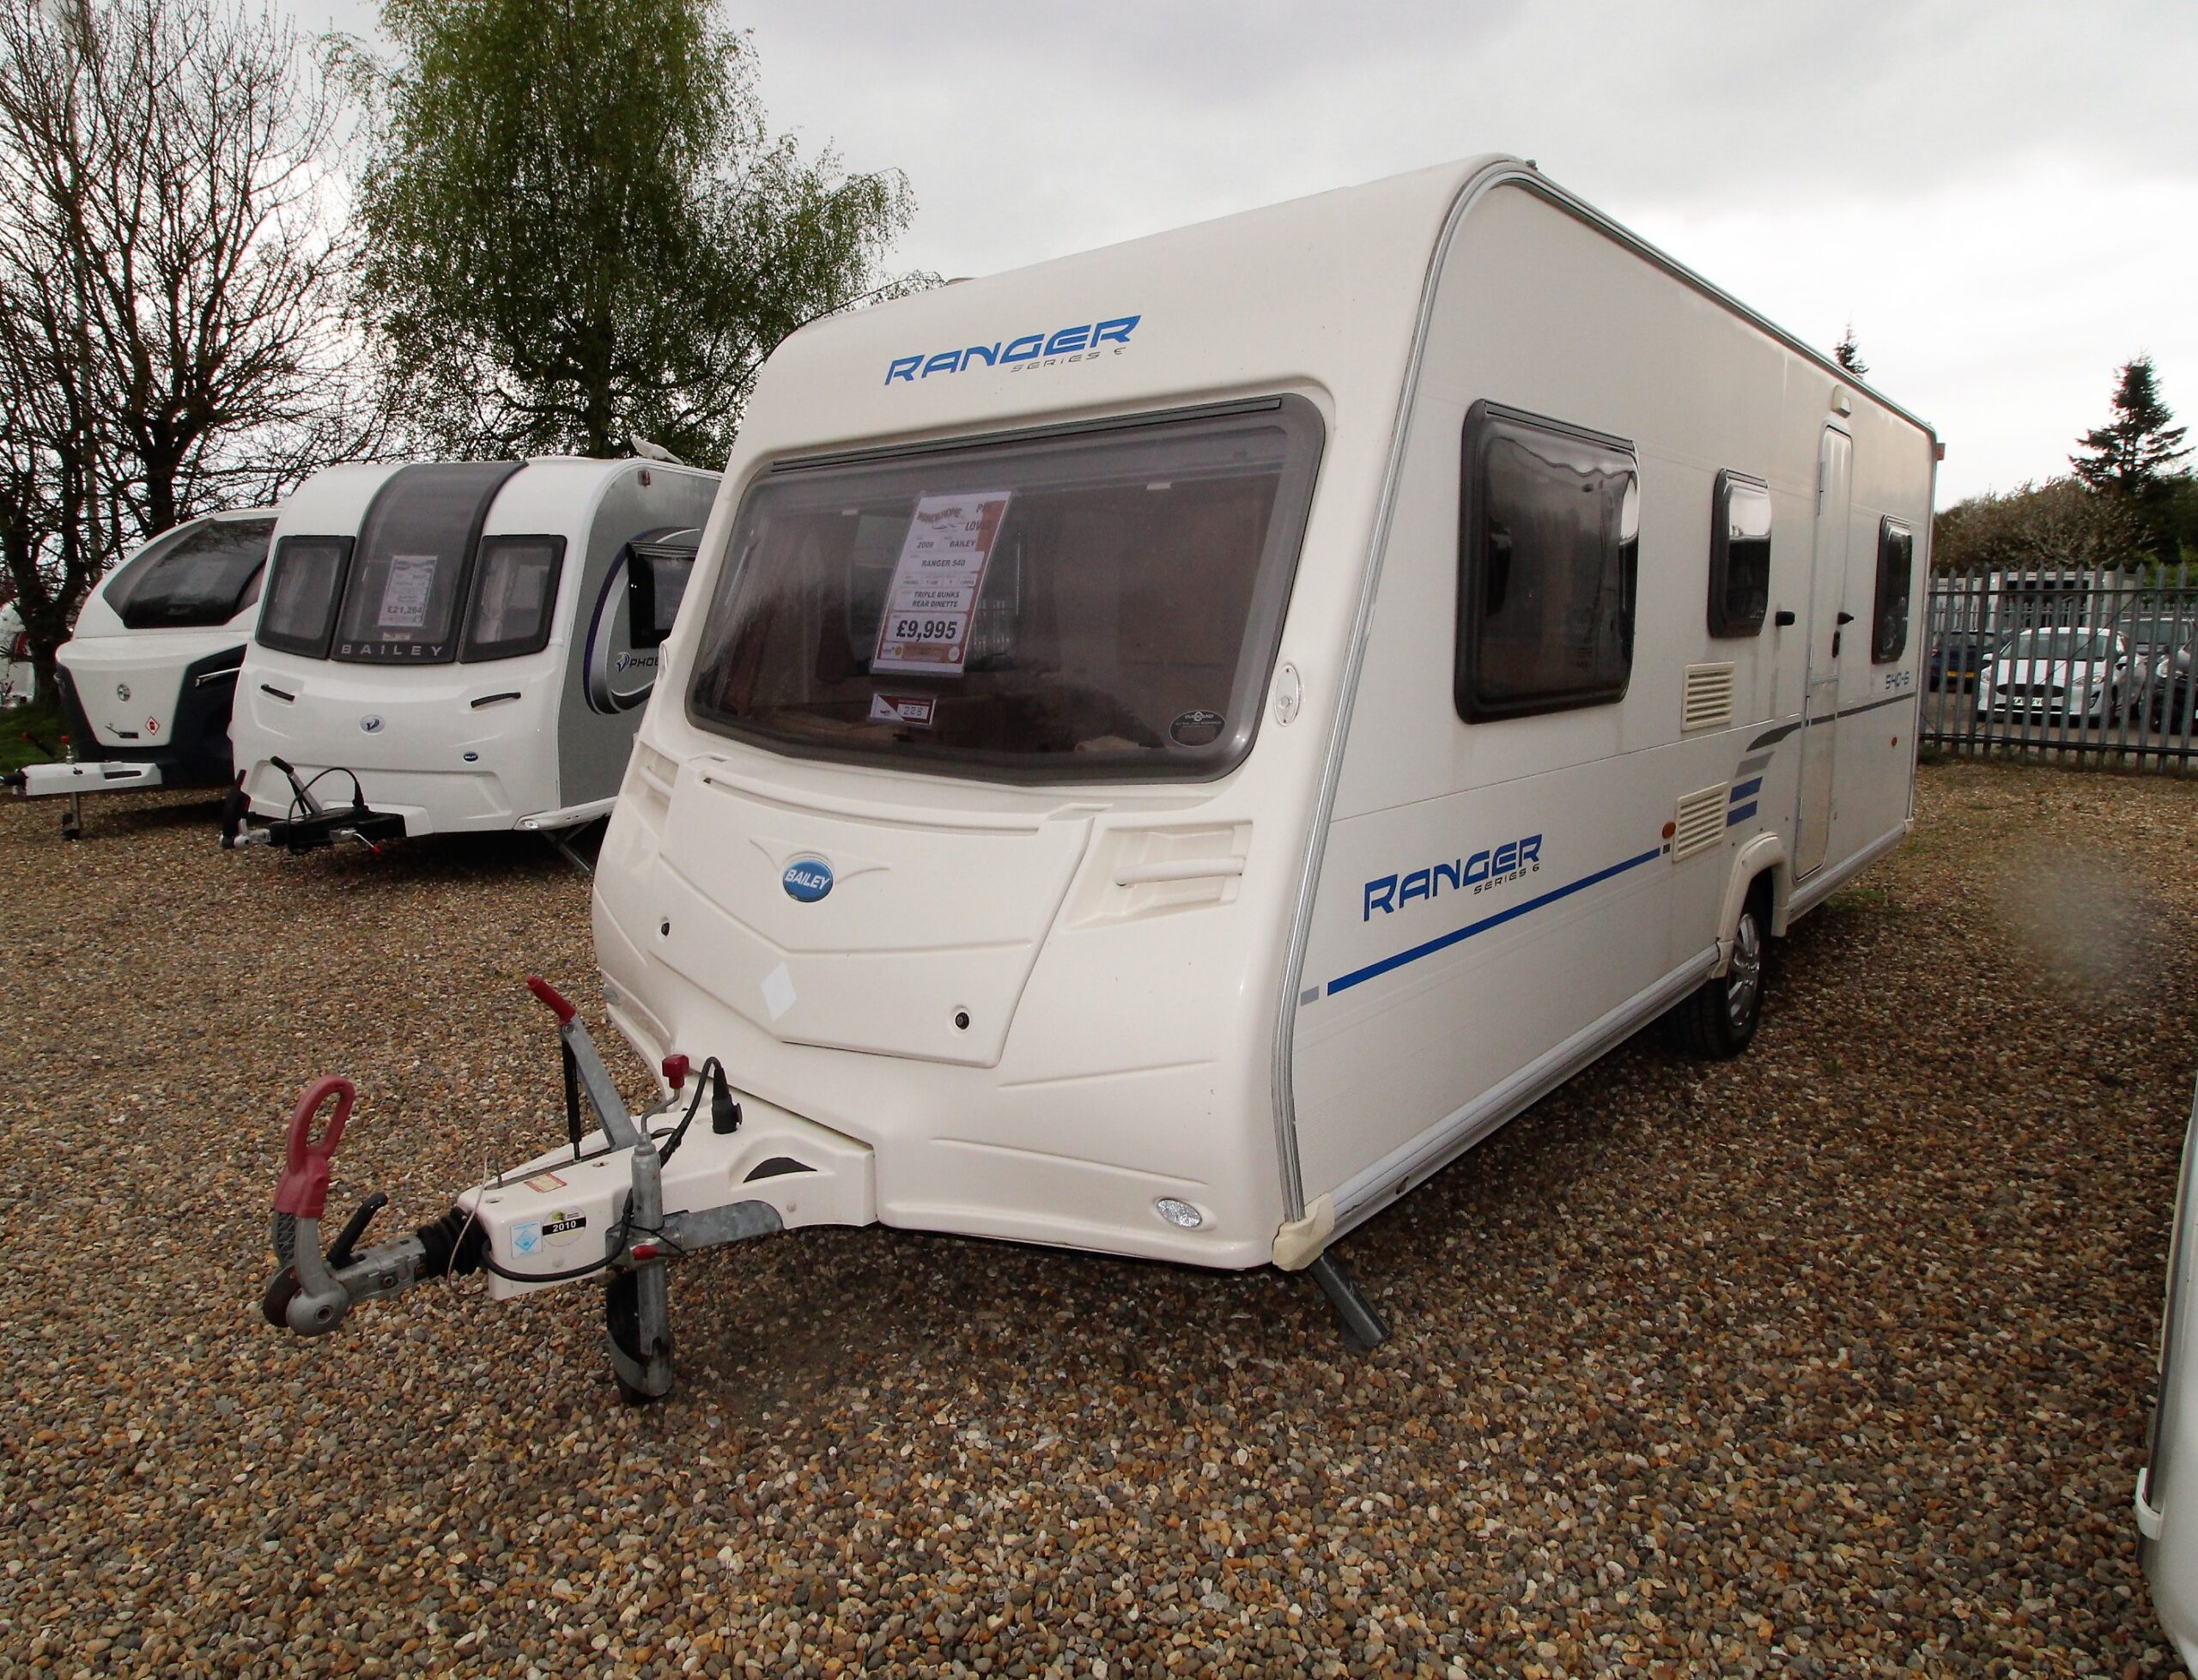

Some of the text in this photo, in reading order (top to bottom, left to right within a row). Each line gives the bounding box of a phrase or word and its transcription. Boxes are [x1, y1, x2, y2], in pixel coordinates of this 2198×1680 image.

[884, 314, 1142, 385] RANGER
[1010, 351, 1101, 373] SERIES
[896, 619, 957, 642] £9,995
[341, 644, 443, 656] BAILEY
[785, 869, 830, 890] BAILEY
[1363, 834, 1543, 922] RANGER
[1473, 863, 1540, 895] SERIES 6
[552, 1221, 576, 1232] 2010
